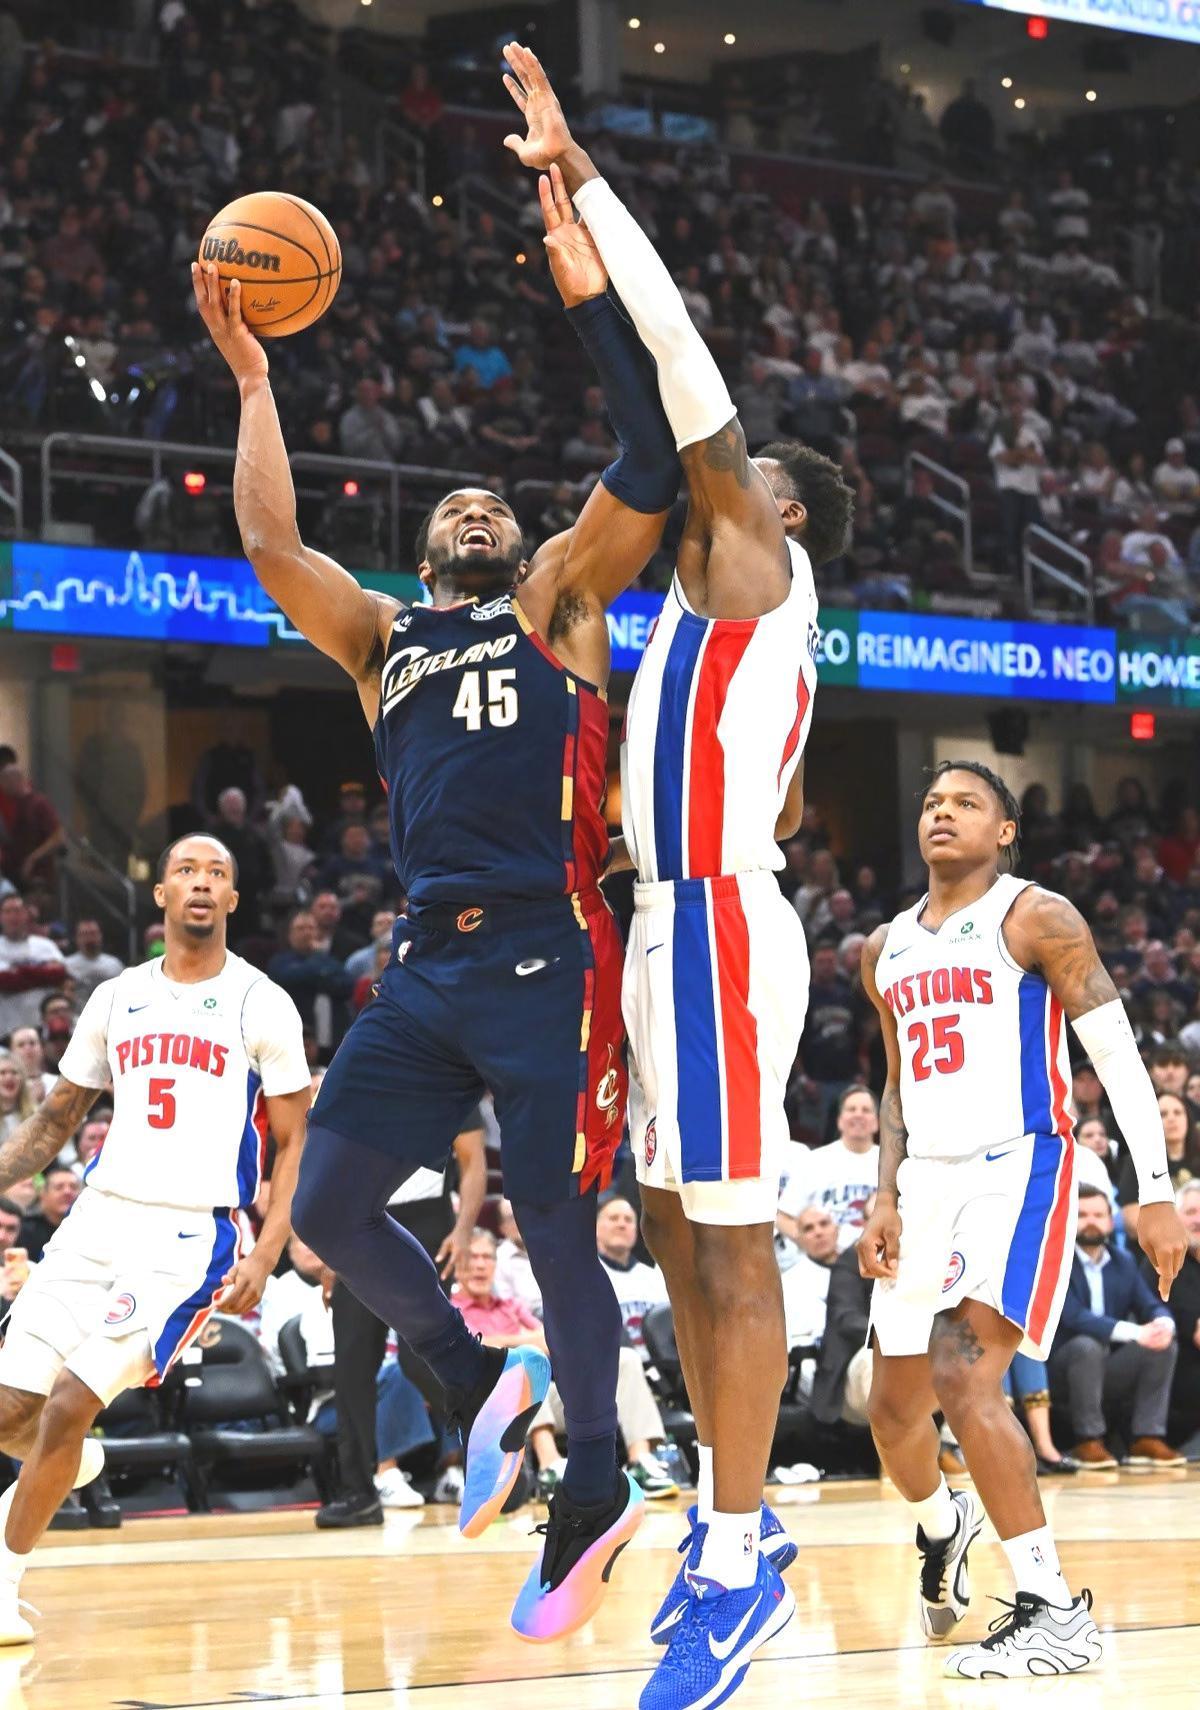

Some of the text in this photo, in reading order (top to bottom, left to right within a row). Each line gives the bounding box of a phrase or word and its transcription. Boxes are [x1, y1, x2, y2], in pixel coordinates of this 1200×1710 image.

[202, 236, 281, 273] Wilson
[605, 613, 658, 649] NE
[382, 633, 518, 719] CLEVELAND
[857, 632, 1046, 678] REIMAGINED.
[1053, 646, 1114, 683] NEO
[452, 668, 518, 731] 45
[884, 966, 993, 1017] PISTONS
[116, 1033, 229, 1077] PISTONS
[907, 1014, 965, 1082] 25
[147, 1078, 176, 1129] 5
